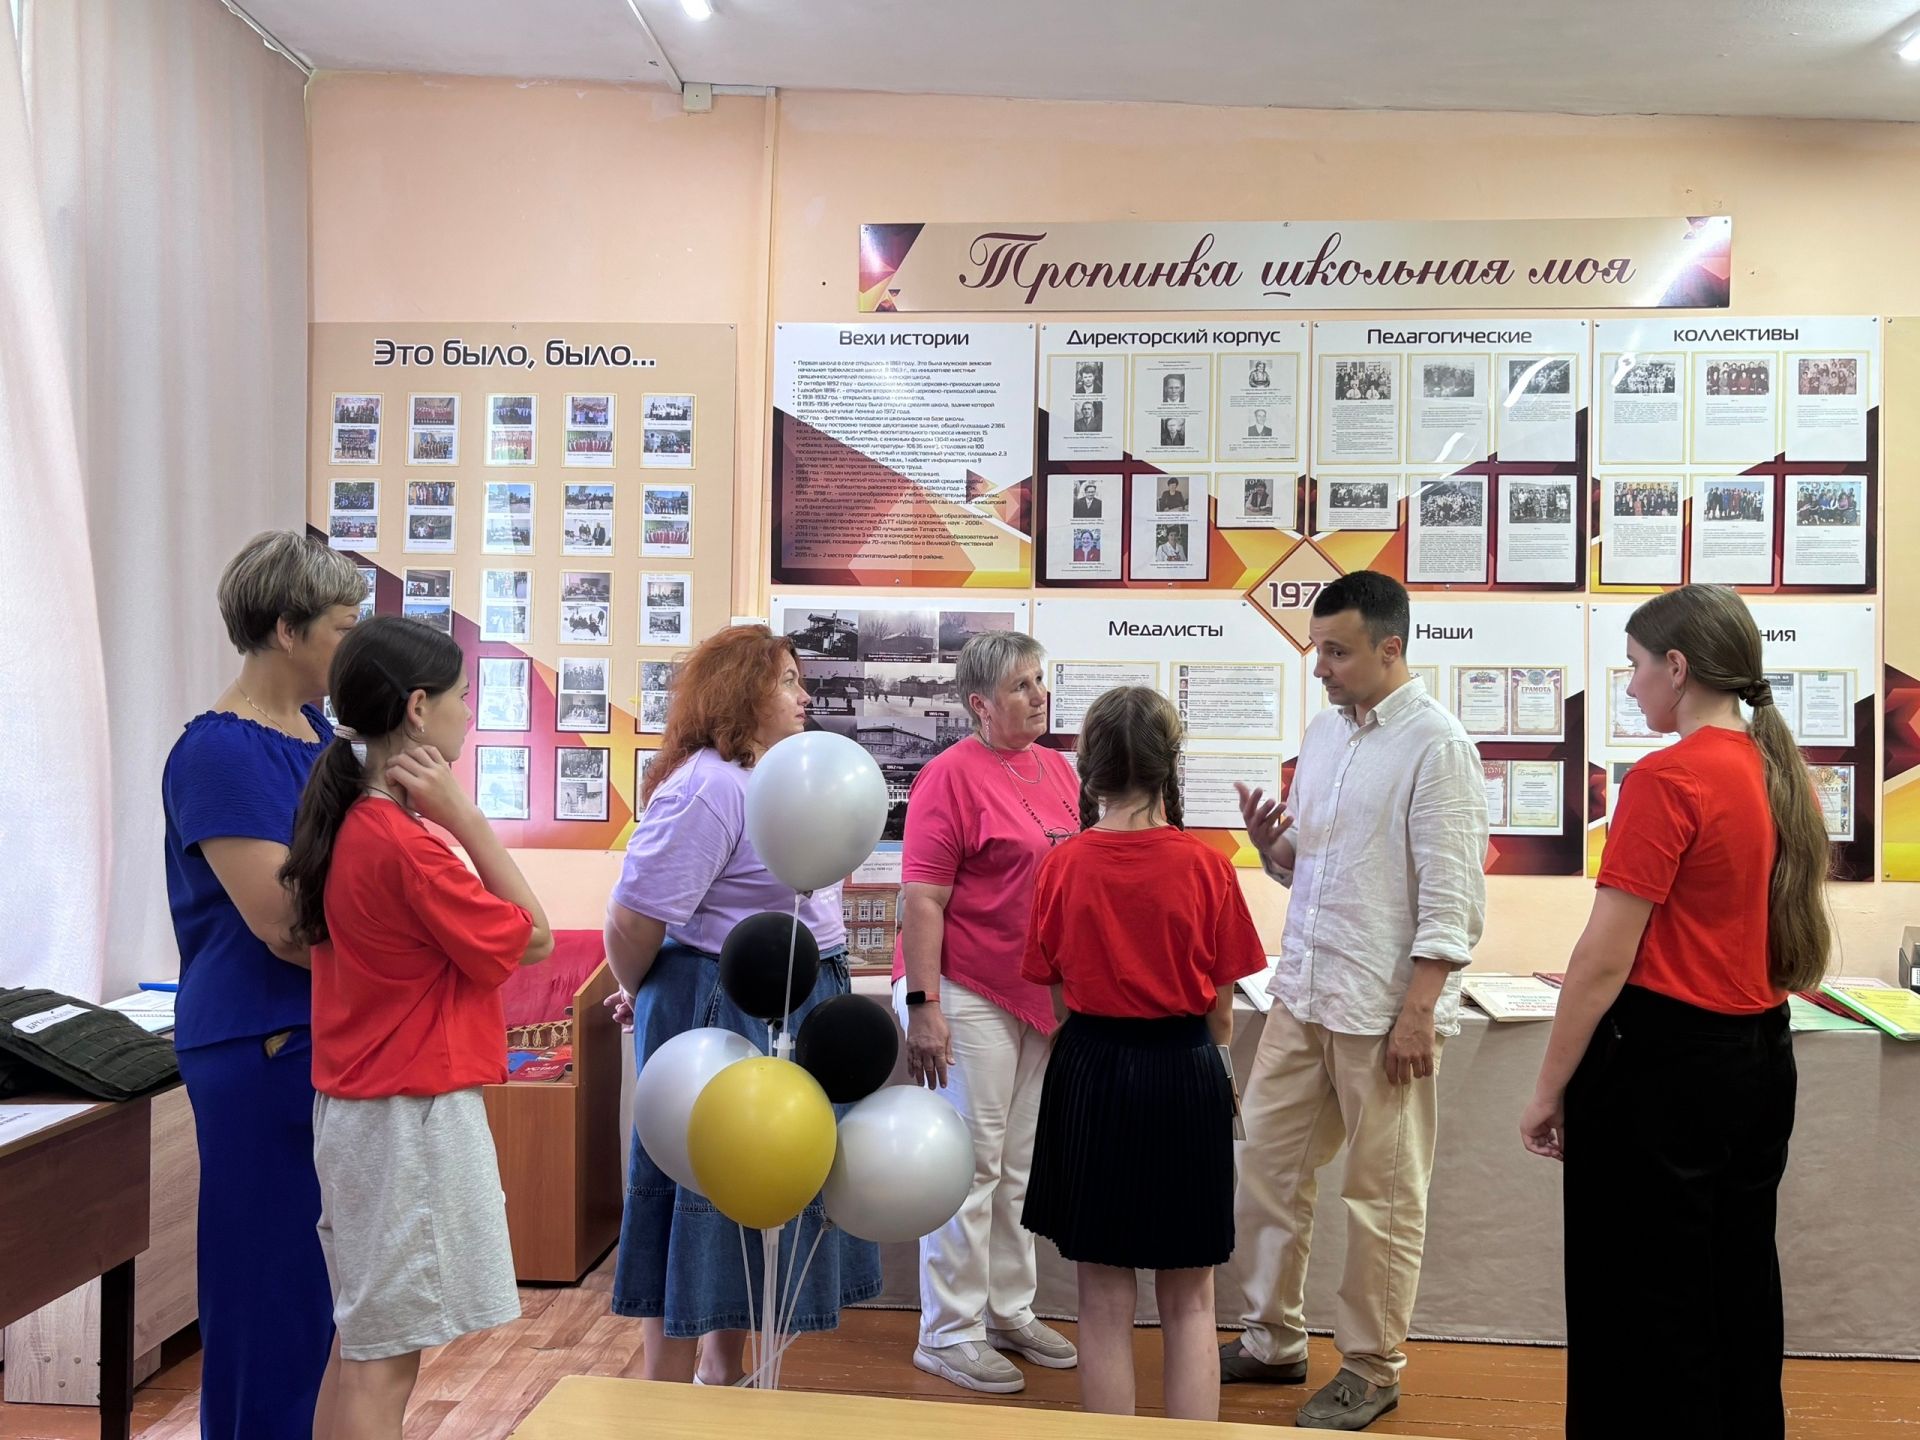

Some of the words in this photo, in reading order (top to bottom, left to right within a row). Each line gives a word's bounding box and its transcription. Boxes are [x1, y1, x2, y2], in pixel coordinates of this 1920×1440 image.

[959, 233, 1243, 304] Тропинка
[1262, 223, 1514, 298] школьная
[1529, 258, 1636, 284] моя
[839, 329, 884, 345] Вехи
[890, 332, 969, 348] истории
[1067, 328, 1208, 348] Директорский
[1213, 331, 1281, 347] корпус
[1367, 328, 1532, 344] Педагогические
[1674, 328, 1799, 342] коллективы
[374, 340, 433, 365] Это
[443, 340, 535, 370] было,
[546, 340, 656, 366] было...
[1269, 583, 1329, 607] 197
[1108, 620, 1223, 637] Медалисты
[1416, 624, 1473, 640] Наши
[1760, 629, 1796, 642] ния
